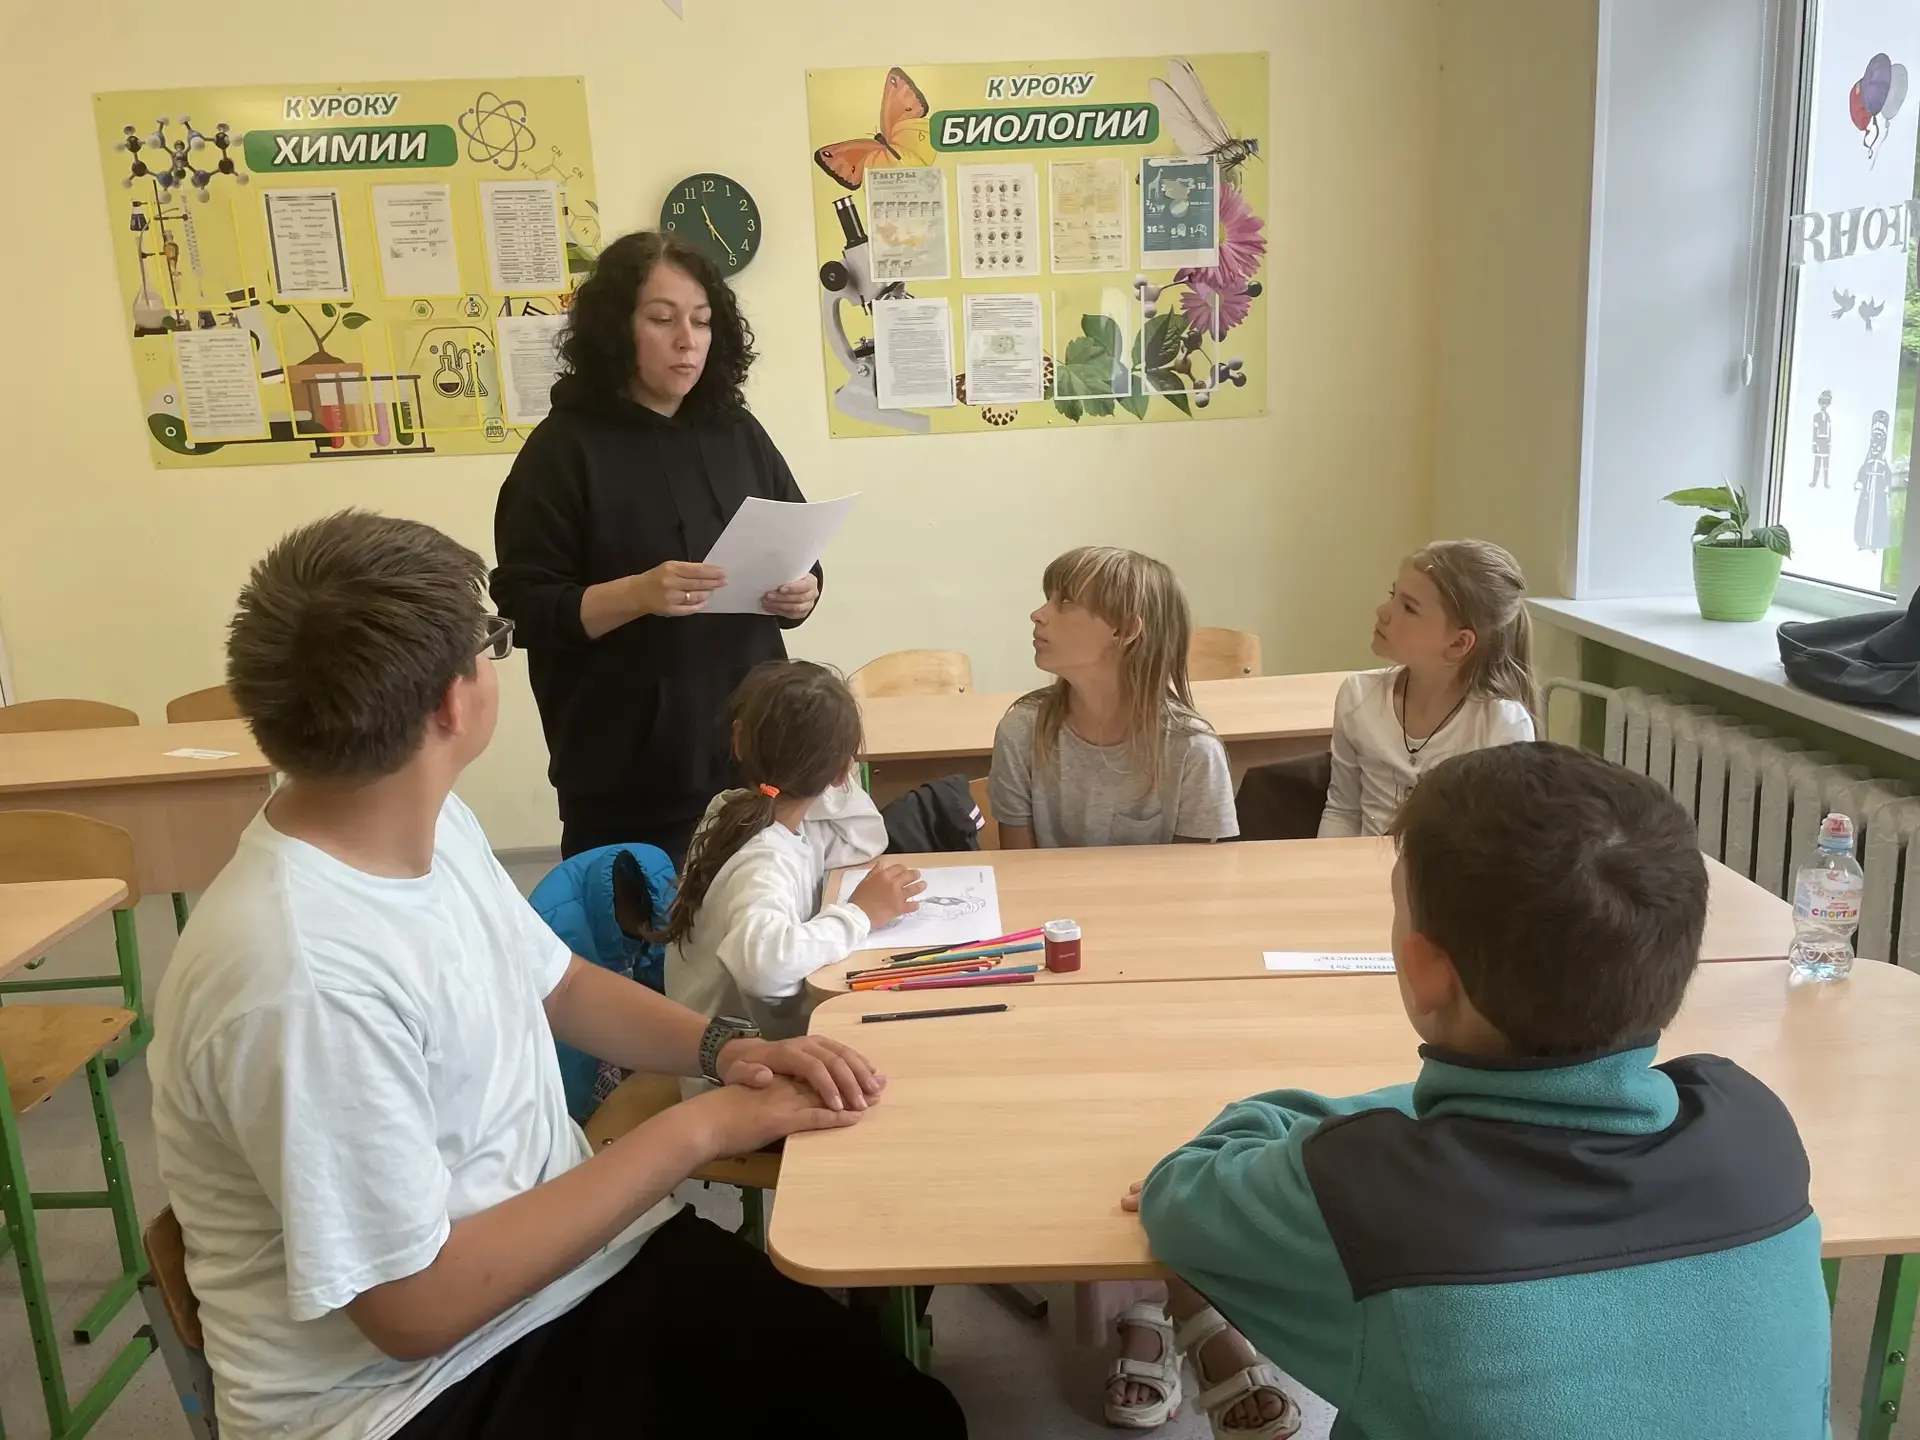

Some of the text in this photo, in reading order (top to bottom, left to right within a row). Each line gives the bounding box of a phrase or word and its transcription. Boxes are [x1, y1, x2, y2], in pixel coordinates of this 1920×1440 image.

[987, 75, 1095, 98] К УРОКУ
[285, 95, 398, 119] К УРОКУ
[941, 109, 1149, 146] БИОЛОГИИ
[272, 131, 427, 165] ХИМИИ
[550, 144, 564, 158] CN
[571, 166, 585, 179] CN
[869, 171, 918, 181] Тигры
[685, 187, 697, 199] 11
[701, 180, 715, 193] 12
[672, 202, 685, 215] 10
[739, 199, 748, 212] 2
[667, 221, 676, 232] 9
[747, 219, 756, 232] 3
[740, 238, 750, 252] 4
[728, 253, 738, 266] 5
